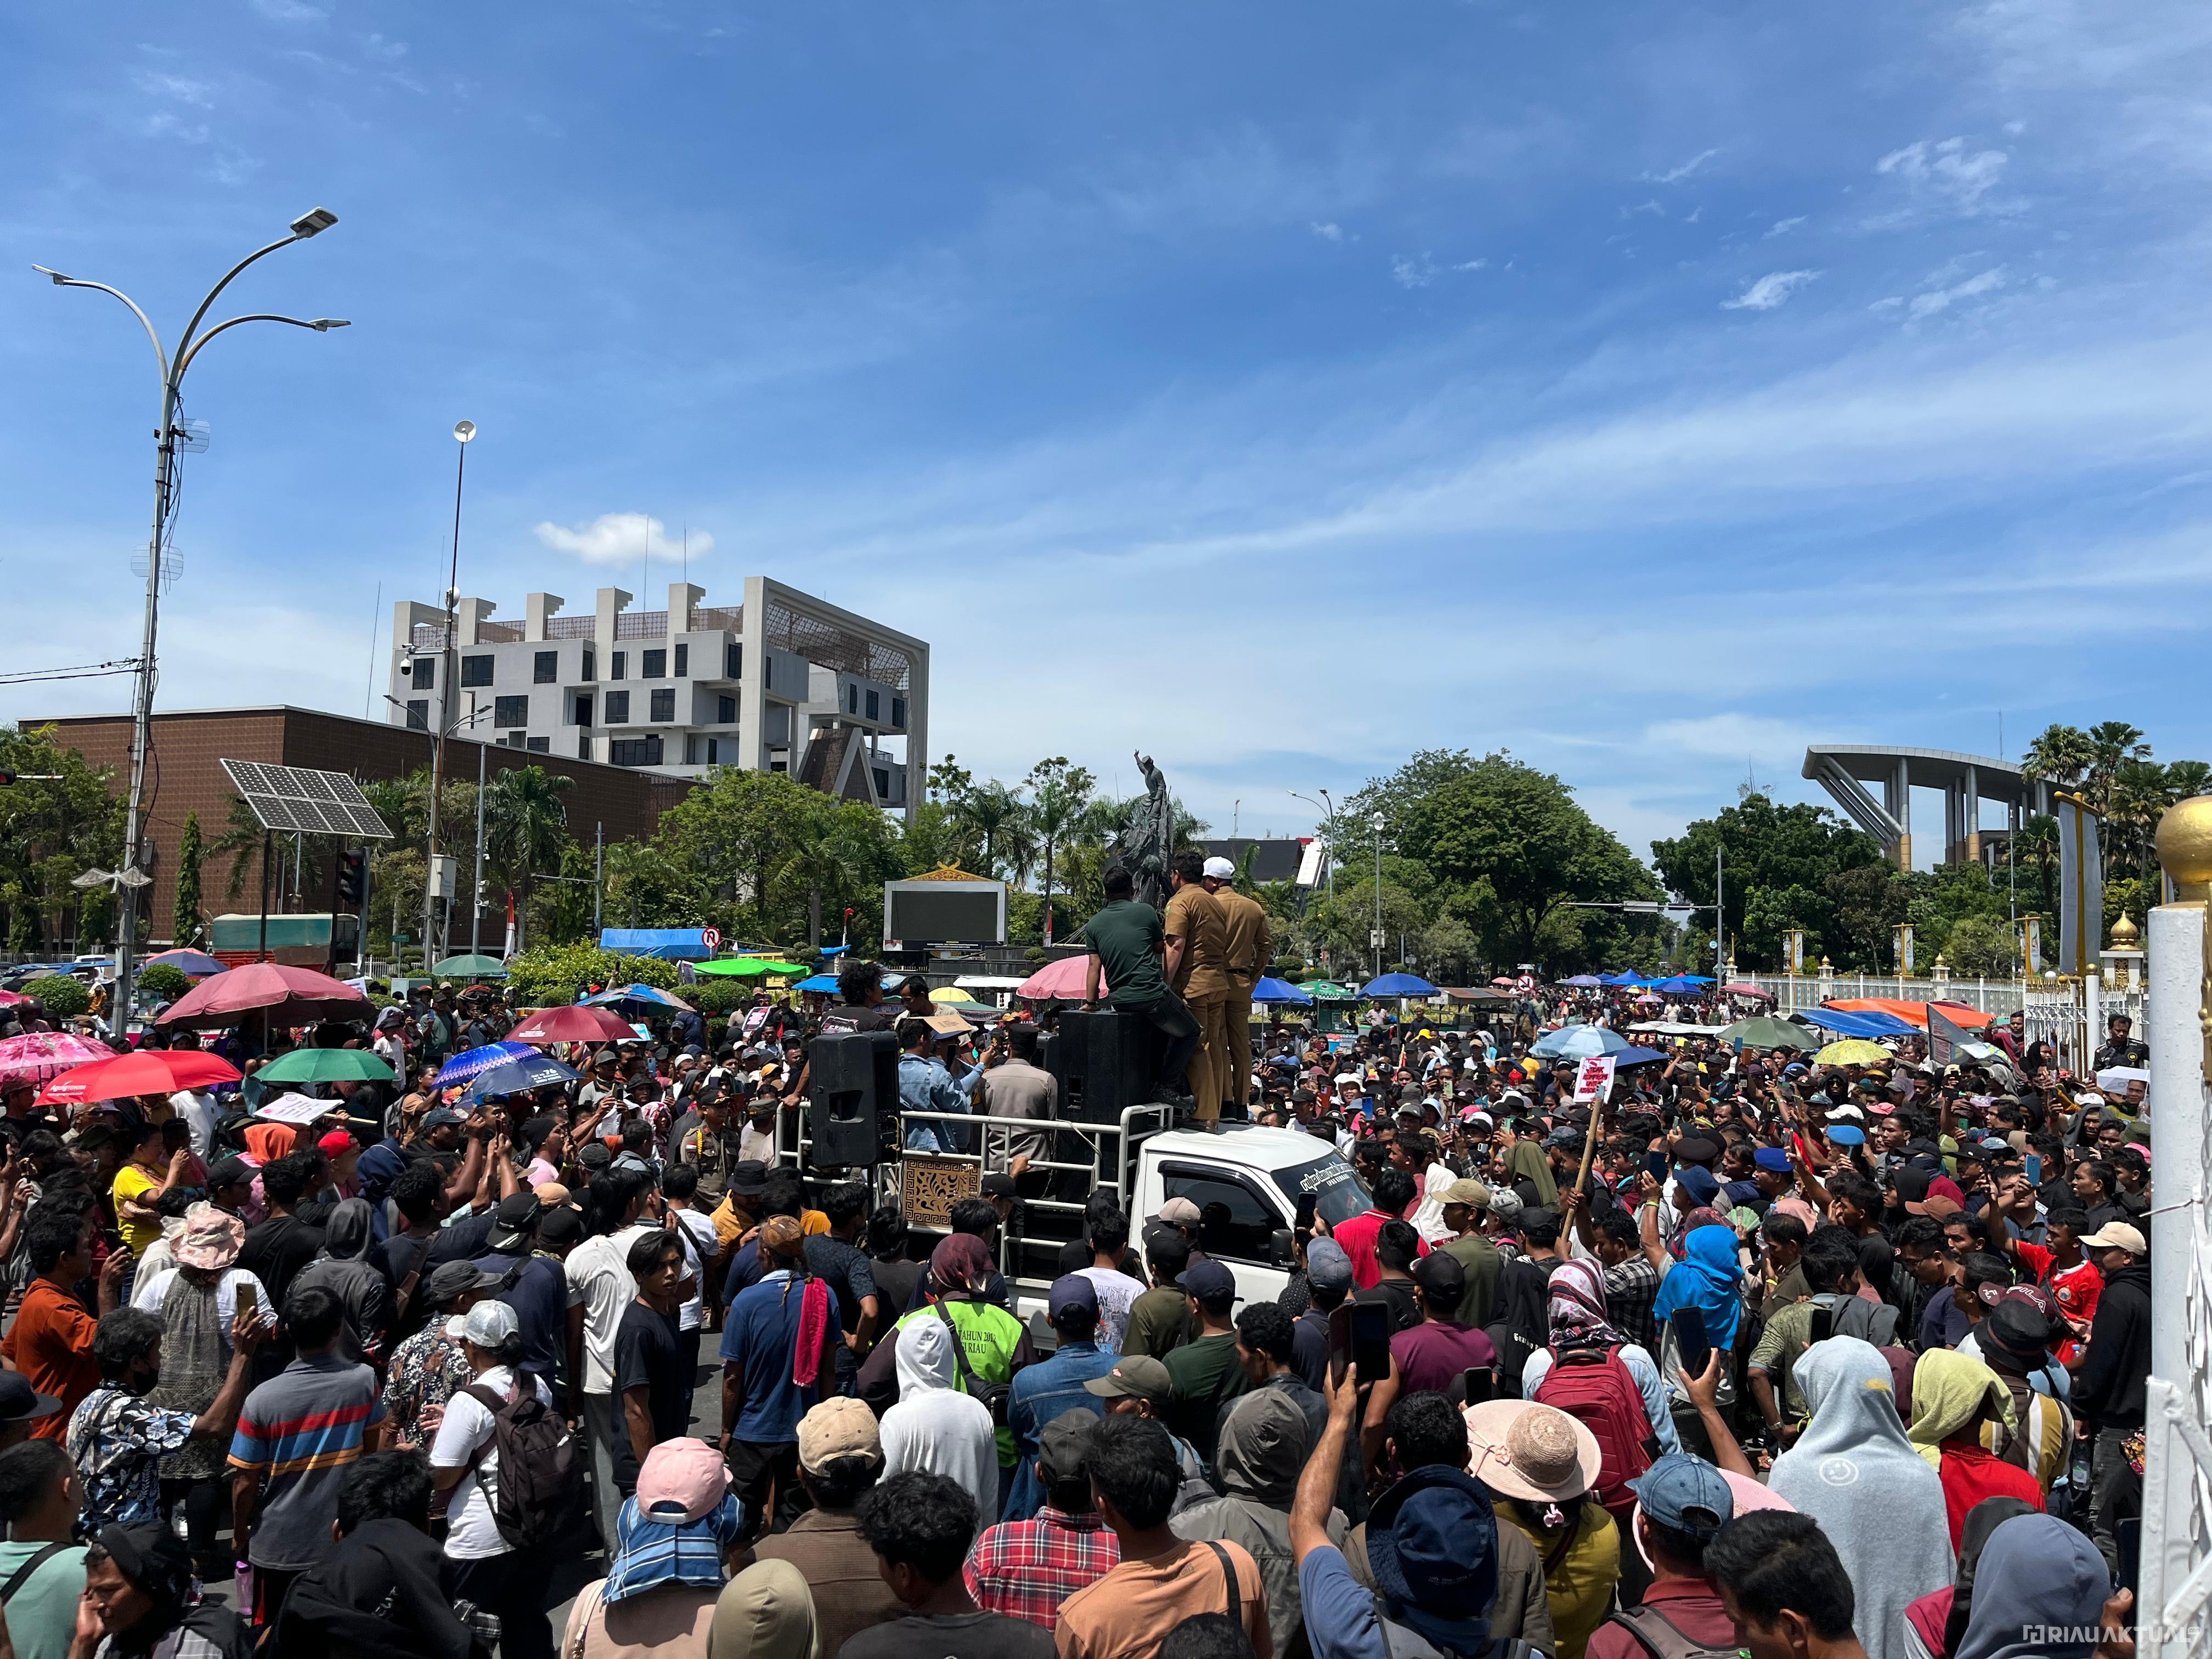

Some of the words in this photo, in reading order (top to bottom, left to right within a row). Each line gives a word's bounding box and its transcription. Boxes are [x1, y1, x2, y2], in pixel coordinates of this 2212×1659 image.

[2006, 1286, 2046, 1313] FILA
[958, 1330, 983, 1341] TAHUN
[968, 1343, 986, 1353] RIAU
